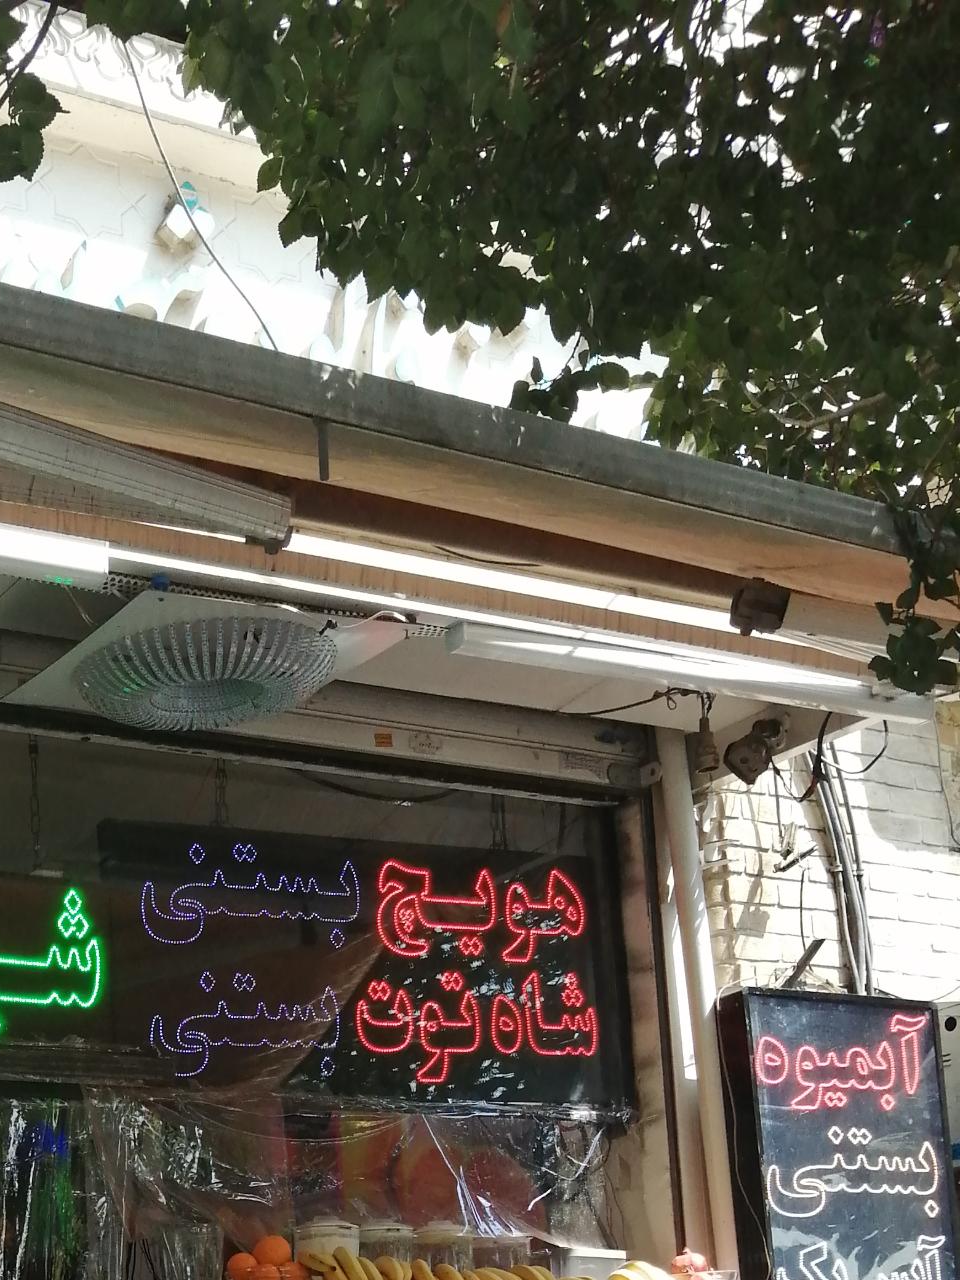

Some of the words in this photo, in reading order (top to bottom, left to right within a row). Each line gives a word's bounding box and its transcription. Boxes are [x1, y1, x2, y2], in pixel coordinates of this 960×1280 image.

[140, 842, 360, 949] بستنی
[377, 858, 586, 963] هویج
[149, 970, 342, 1078] بستنی
[355, 969, 480, 1084] توت
[490, 970, 599, 1058] شاه
[755, 1014, 929, 1111] آبمیوه
[767, 1126, 940, 1218] بستنی
